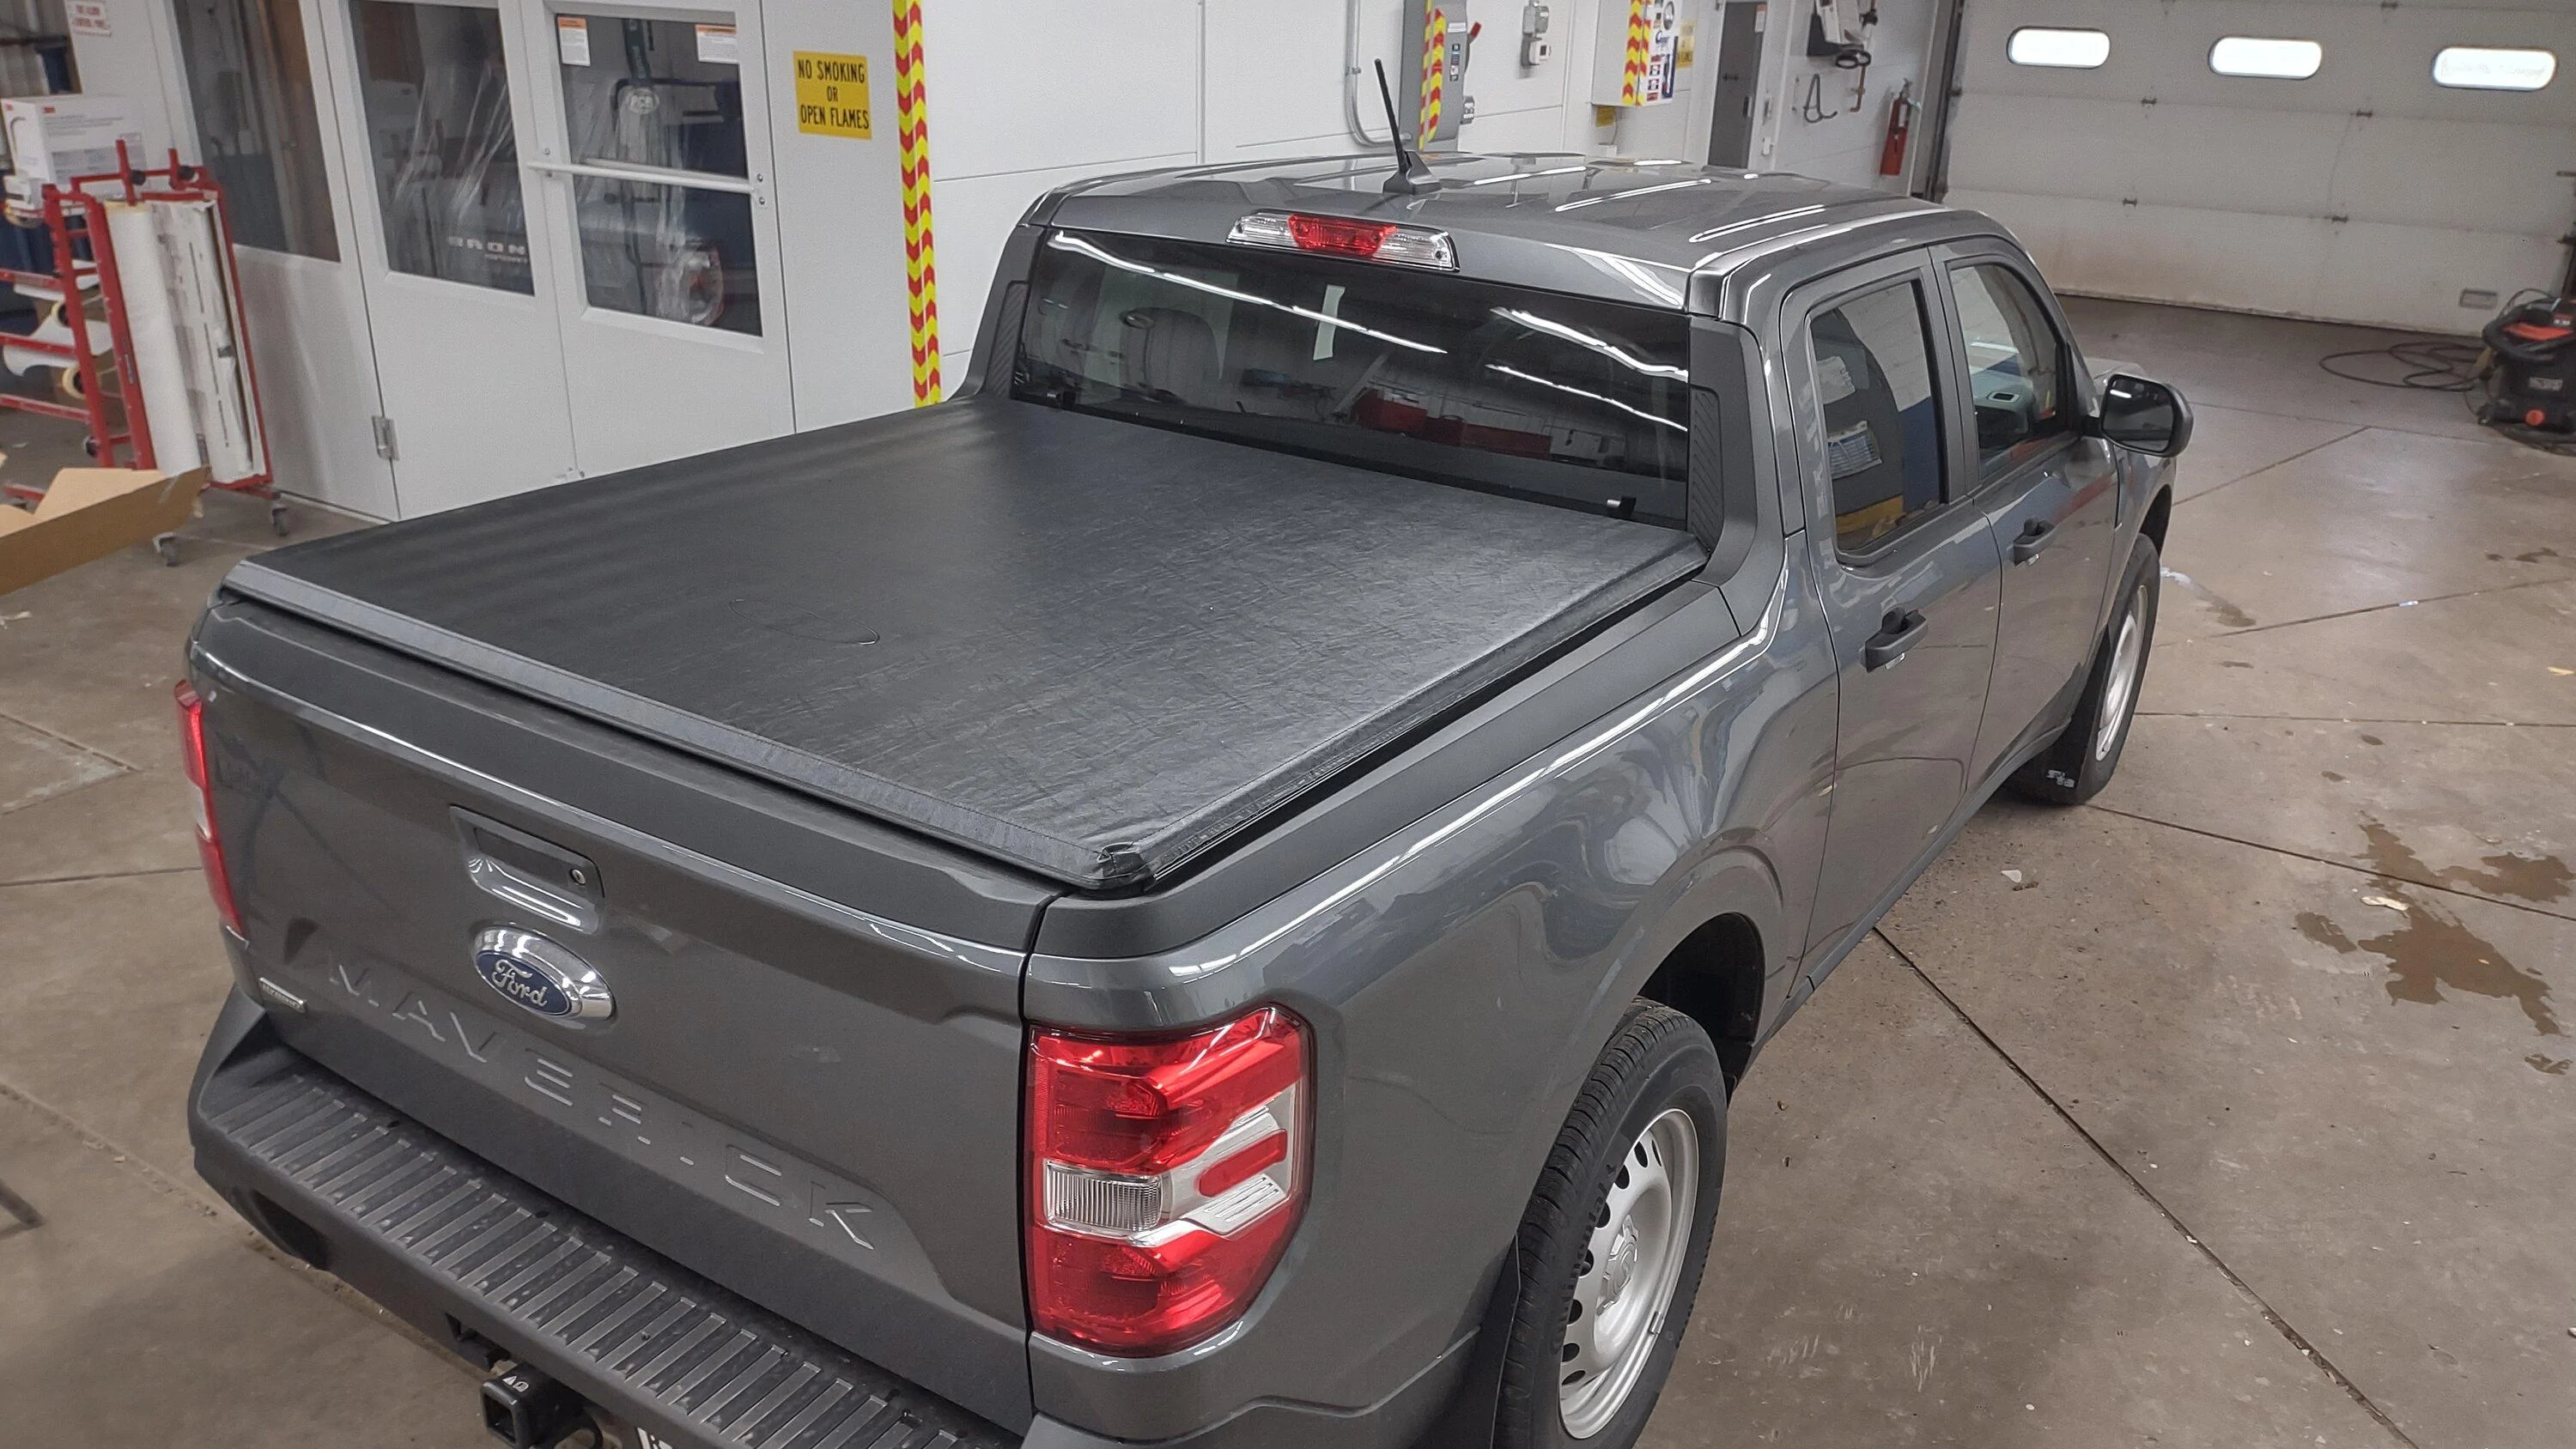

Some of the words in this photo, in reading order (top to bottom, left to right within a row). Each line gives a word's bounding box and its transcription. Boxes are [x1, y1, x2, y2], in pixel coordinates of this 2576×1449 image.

[798, 59, 812, 79] NO
[817, 60, 866, 83] SMOKING
[827, 86, 838, 102] OR
[800, 105, 826, 125] OPEN
[830, 107, 869, 130] FLAMES
[491, 959, 548, 1007] Ford
[330, 961, 875, 1251] MAVERICK
